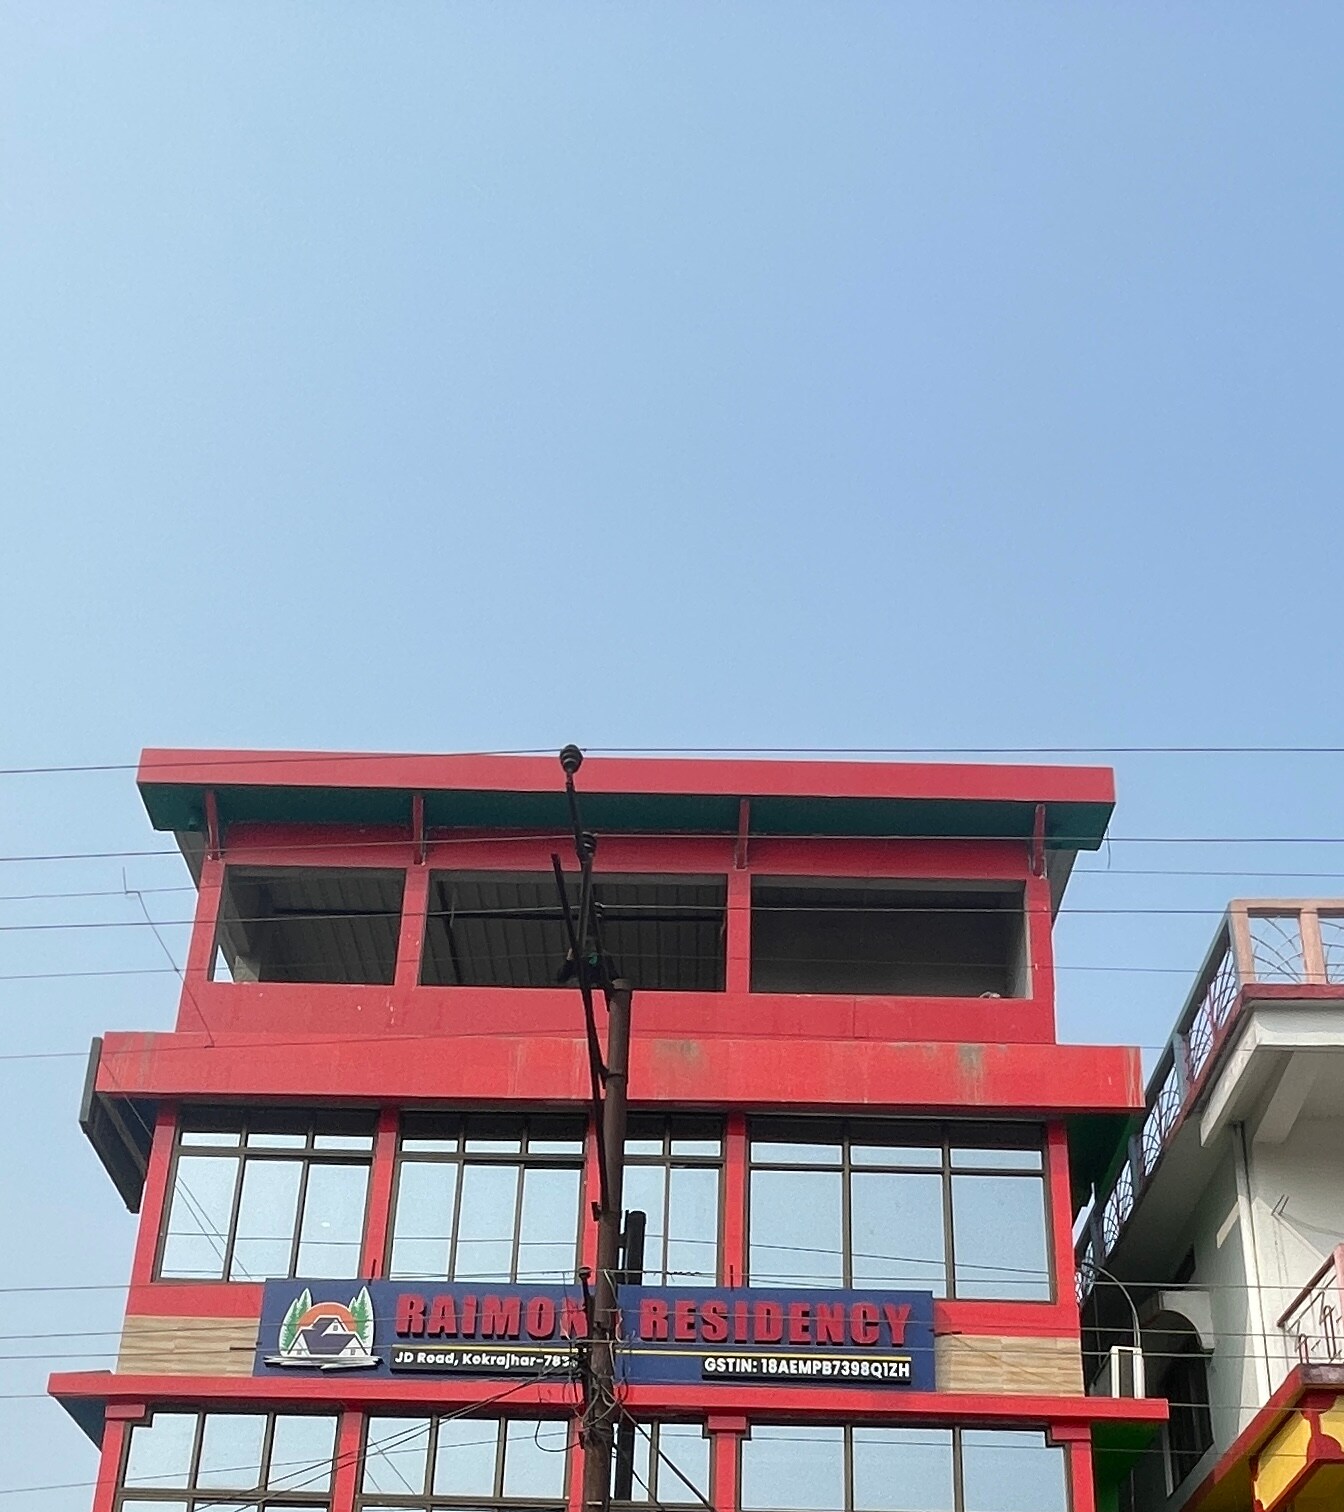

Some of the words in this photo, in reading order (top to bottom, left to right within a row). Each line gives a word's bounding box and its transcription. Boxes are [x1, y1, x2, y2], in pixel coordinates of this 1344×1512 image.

[396, 1293, 622, 1341] RAIMON
[640, 1299, 911, 1347] RESIDENCY
[395, 1352, 414, 1363] JD
[417, 1353, 459, 1366] Road,
[704, 1357, 757, 1373] GSTIN:
